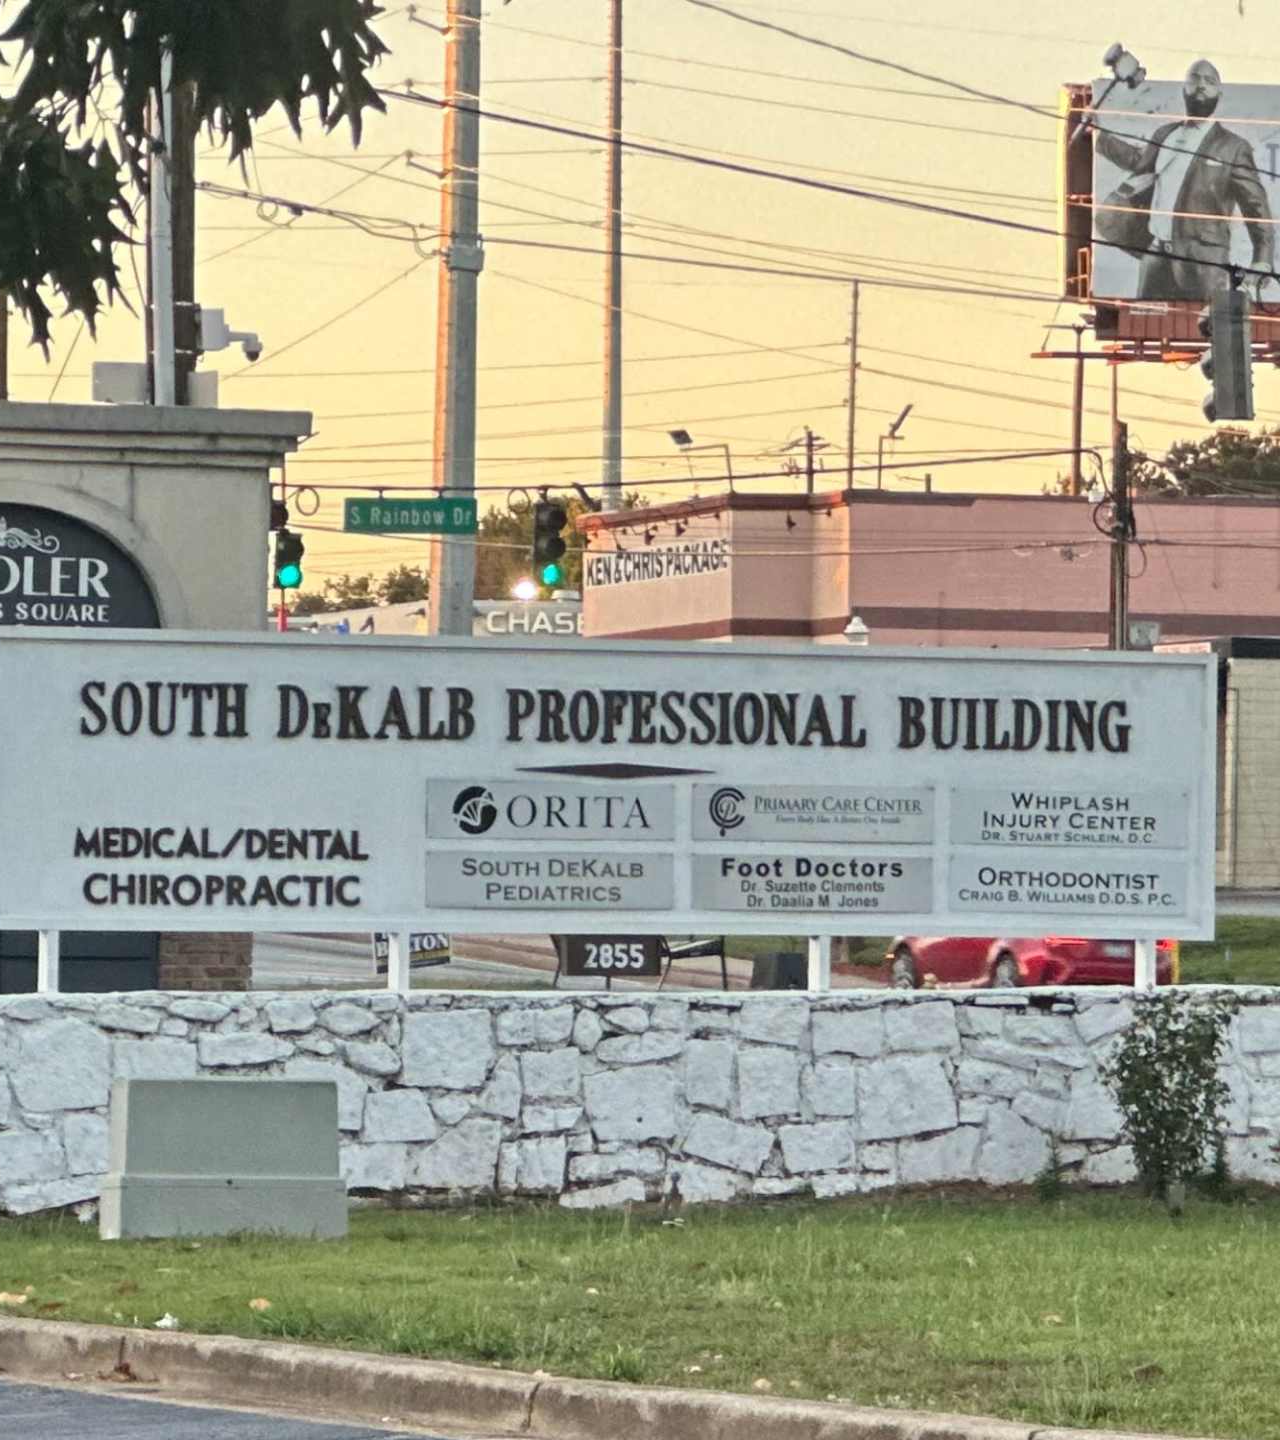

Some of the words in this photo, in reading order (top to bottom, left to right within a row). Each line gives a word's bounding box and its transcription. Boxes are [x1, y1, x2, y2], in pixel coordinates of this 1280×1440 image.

[351, 508, 362, 524] S
[370, 507, 445, 526] Rainbow
[453, 508, 471, 526] Dr
[586, 556, 612, 586] KEN
[623, 548, 663, 583] CHRIS
[665, 538, 729, 577] PACKAGE
[16, 602, 110, 623] SQUARE
[80, 681, 249, 738] SOUTH
[505, 687, 867, 748] PROFESSIONAL
[898, 696, 1133, 753] BUILDING
[506, 794, 652, 829] ORITA
[754, 795, 818, 812] PRIMARY
[821, 796, 859, 812] CARE
[863, 796, 923, 813] CENTER
[1011, 792, 1130, 811] WHIPLASH
[983, 811, 1060, 829] INJURY
[1069, 813, 1157, 831] CENTER
[73, 827, 369, 862] MEDICAL/DENTAL
[1009, 831, 1060, 842] STUART
[461, 857, 540, 877] SOUTH
[721, 858, 783, 877] Foot
[795, 858, 904, 877] Doctors
[765, 880, 817, 893] Suzette
[821, 880, 885, 893] Clements
[978, 866, 1160, 890] ORTHODONTIST
[82, 873, 362, 908] CHIROPRACTIC
[485, 882, 622, 902] PEDIATRICS
[958, 888, 1003, 901] CRAIG
[1007, 889, 1022, 901] B.
[1027, 890, 1095, 904] WILLIAMS
[838, 894, 879, 908] Jones
[583, 943, 645, 969] 2855
